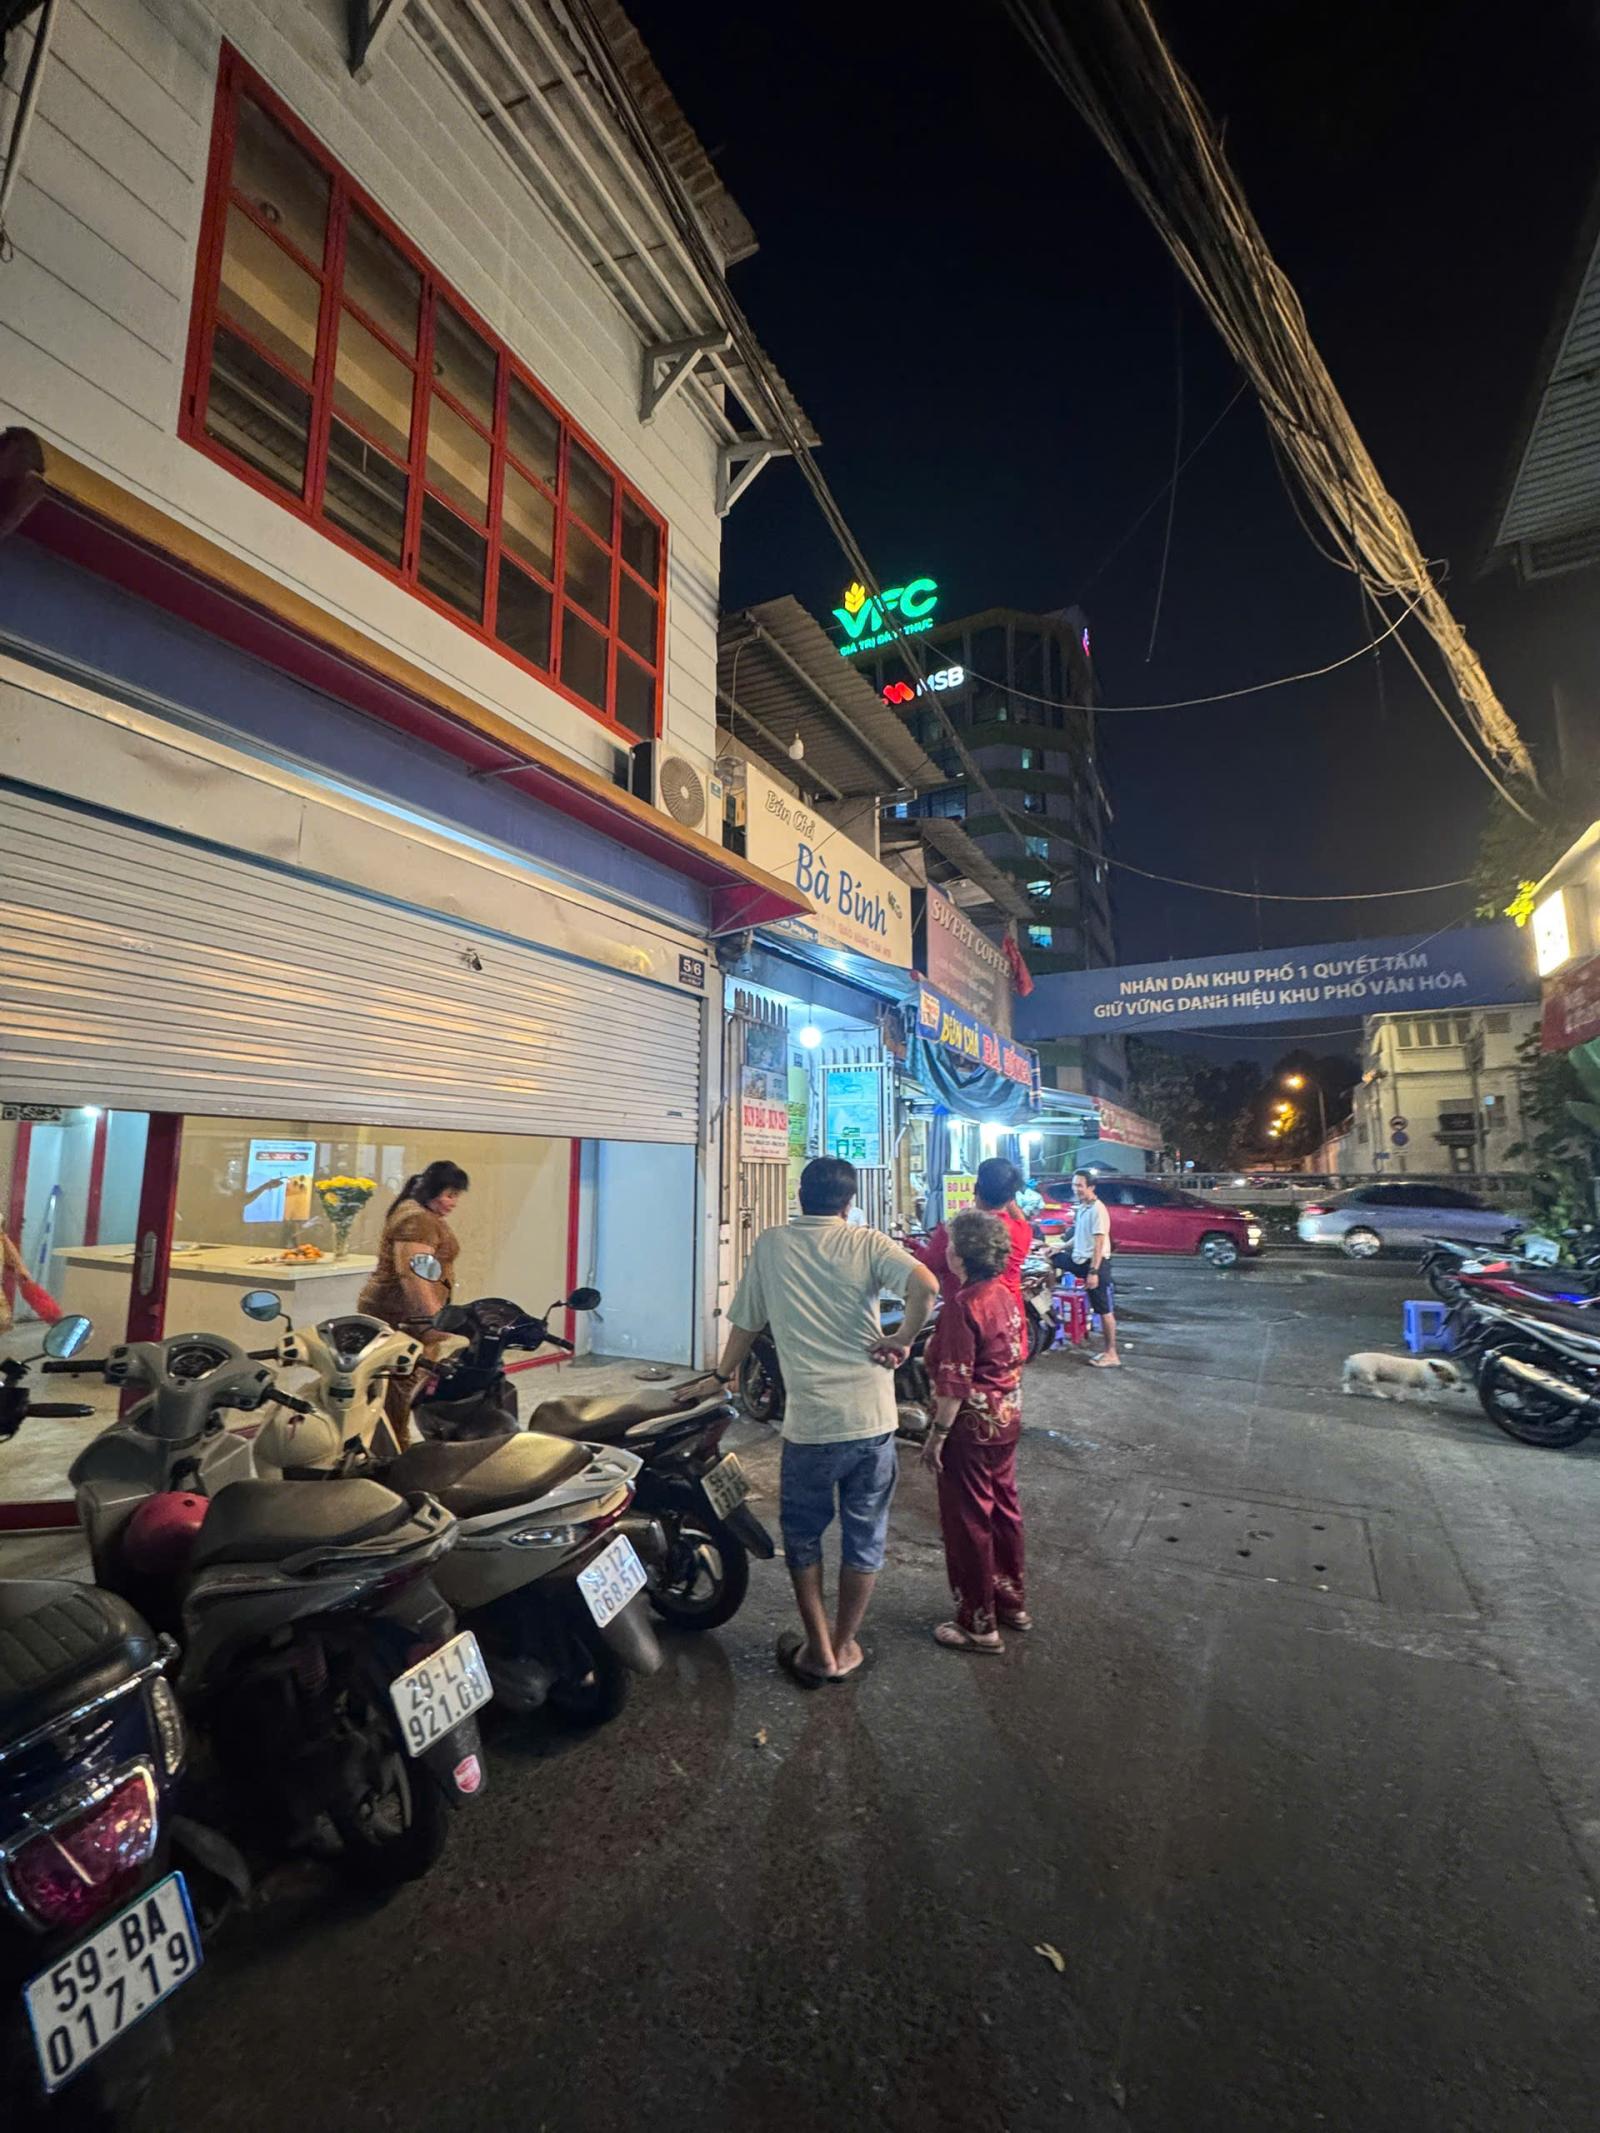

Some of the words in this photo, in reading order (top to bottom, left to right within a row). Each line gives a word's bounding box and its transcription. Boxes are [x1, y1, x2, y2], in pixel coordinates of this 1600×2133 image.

[764, 789, 792, 827] Bún
[792, 809, 816, 841] Chả
[795, 842, 831, 904] Bà
[931, 899, 975, 950] SWEET
[975, 937, 1010, 977] COFFEE
[1093, 1000, 1123, 1018] GIỮ
[1124, 998, 1174, 1016] VỮNG
[1177, 995, 1229, 1012] DANH
[1232, 989, 1275, 1009] HIỆU
[1279, 987, 1320, 1005] KHU
[1324, 977, 1367, 1000] PHỐ
[1369, 976, 1415, 996] VĂN
[1418, 970, 1468, 991] HÓA
[1120, 976, 1168, 996] NHÂN
[1171, 972, 1209, 991] DÂN
[1212, 970, 1250, 987] KHU
[1254, 962, 1294, 983] PHỐ
[1298, 965, 1308, 979] 1
[1313, 952, 1380, 978] QUYẾT
[1380, 952, 1428, 972] TÂM
[940, 1010, 962, 1050] BÚN
[963, 1022, 980, 1058] CHẢ
[406, 1645, 467, 1710] 29-L1
[409, 1670, 484, 1747] 921.08
[52, 1897, 167, 2014] 59-BA
[47, 1931, 190, 2076] 017.19
